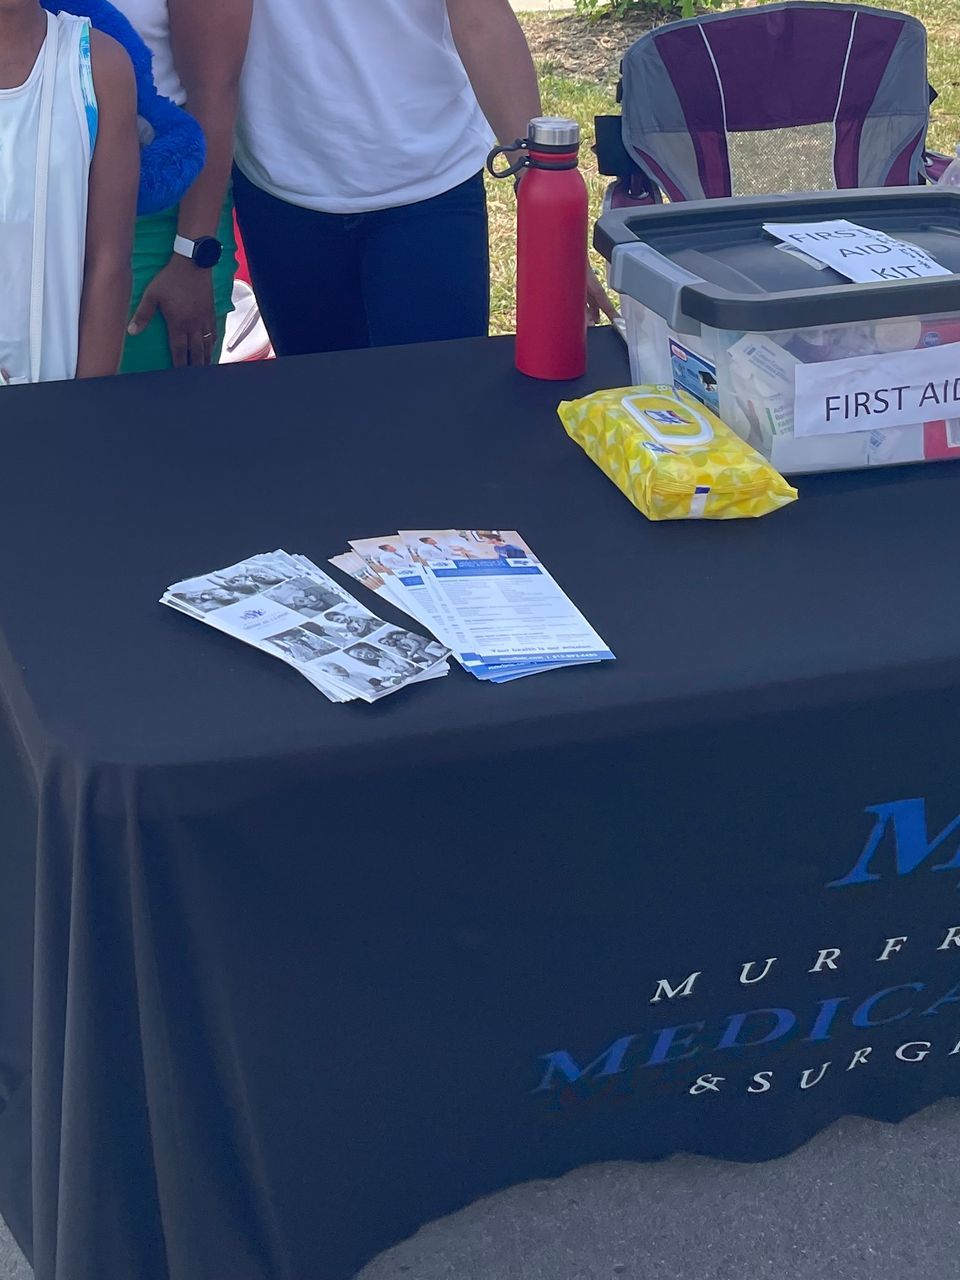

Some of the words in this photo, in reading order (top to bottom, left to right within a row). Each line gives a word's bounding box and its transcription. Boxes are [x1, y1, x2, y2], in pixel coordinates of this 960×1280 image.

[788, 228, 868, 243] FIRST
[839, 244, 892, 258] AID
[870, 265, 922, 280] KIT
[825, 385, 911, 422] FIRST
[825, 797, 960, 887] M
[649, 926, 960, 1004] MURFR
[530, 981, 960, 1094] MEDICA
